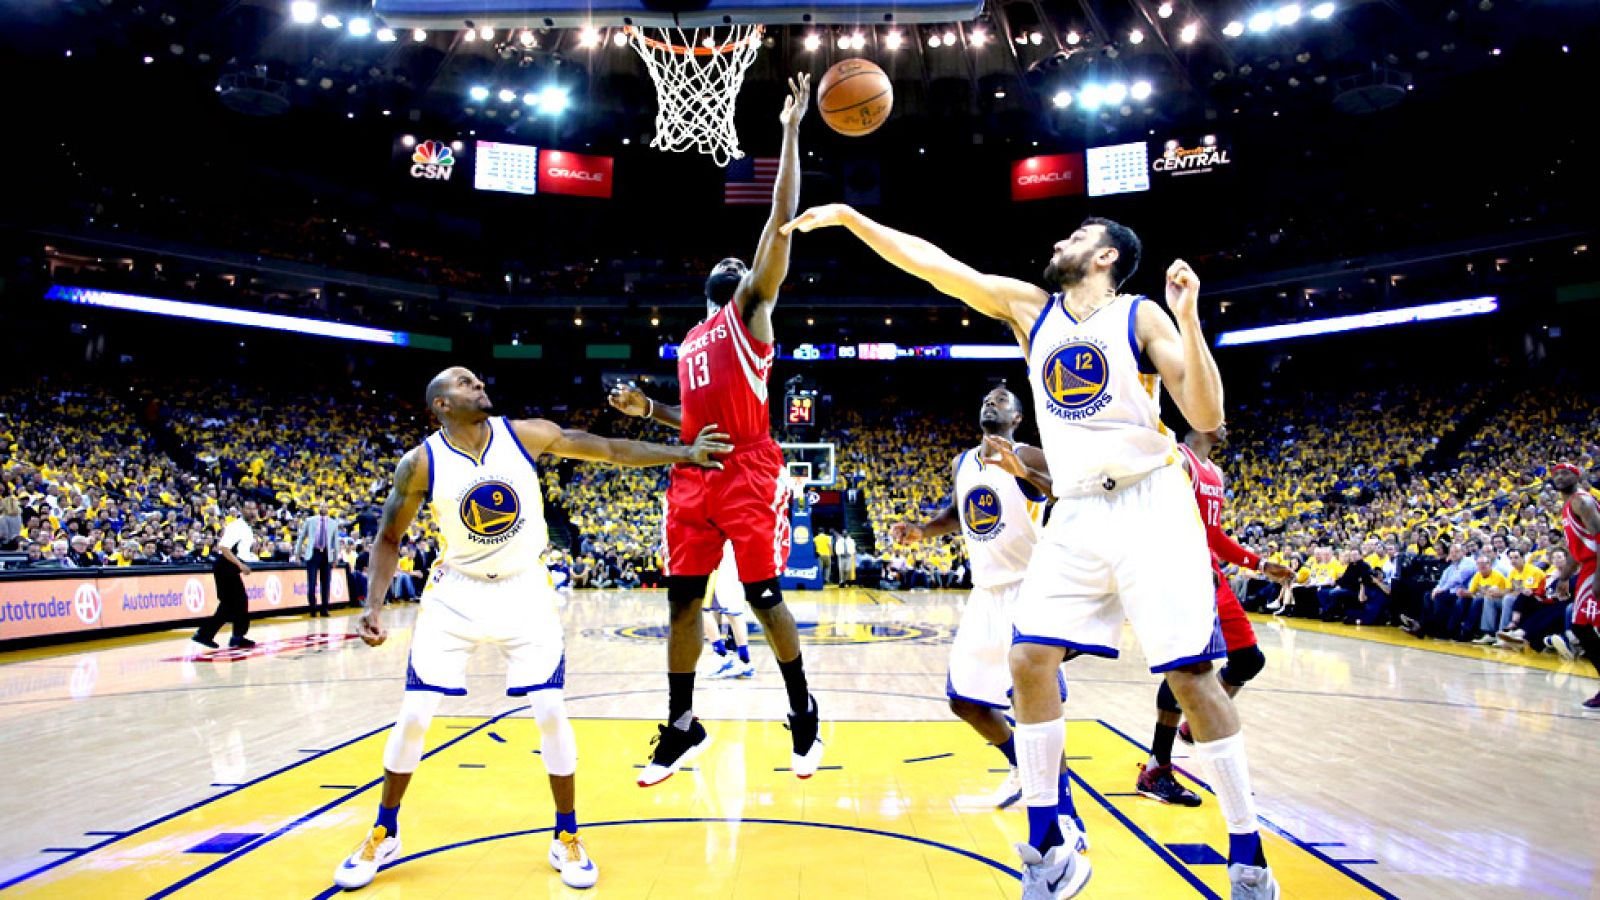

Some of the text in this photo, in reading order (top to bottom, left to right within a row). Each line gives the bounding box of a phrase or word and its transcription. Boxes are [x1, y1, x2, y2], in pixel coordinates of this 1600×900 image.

[1152, 150, 1231, 172] CENTRAL
[411, 164, 452, 180] CSN
[548, 167, 603, 182] ORACLE
[1017, 171, 1071, 186] ORACLE
[1075, 351, 1094, 370] 12
[686, 350, 711, 391] 13
[789, 407, 809, 422] 24
[1046, 392, 1113, 421] WARRIORS
[492, 490, 504, 506] 9
[978, 494, 994, 507] 40
[0, 594, 72, 623] utotrader
[122, 589, 184, 611] Autotrader
